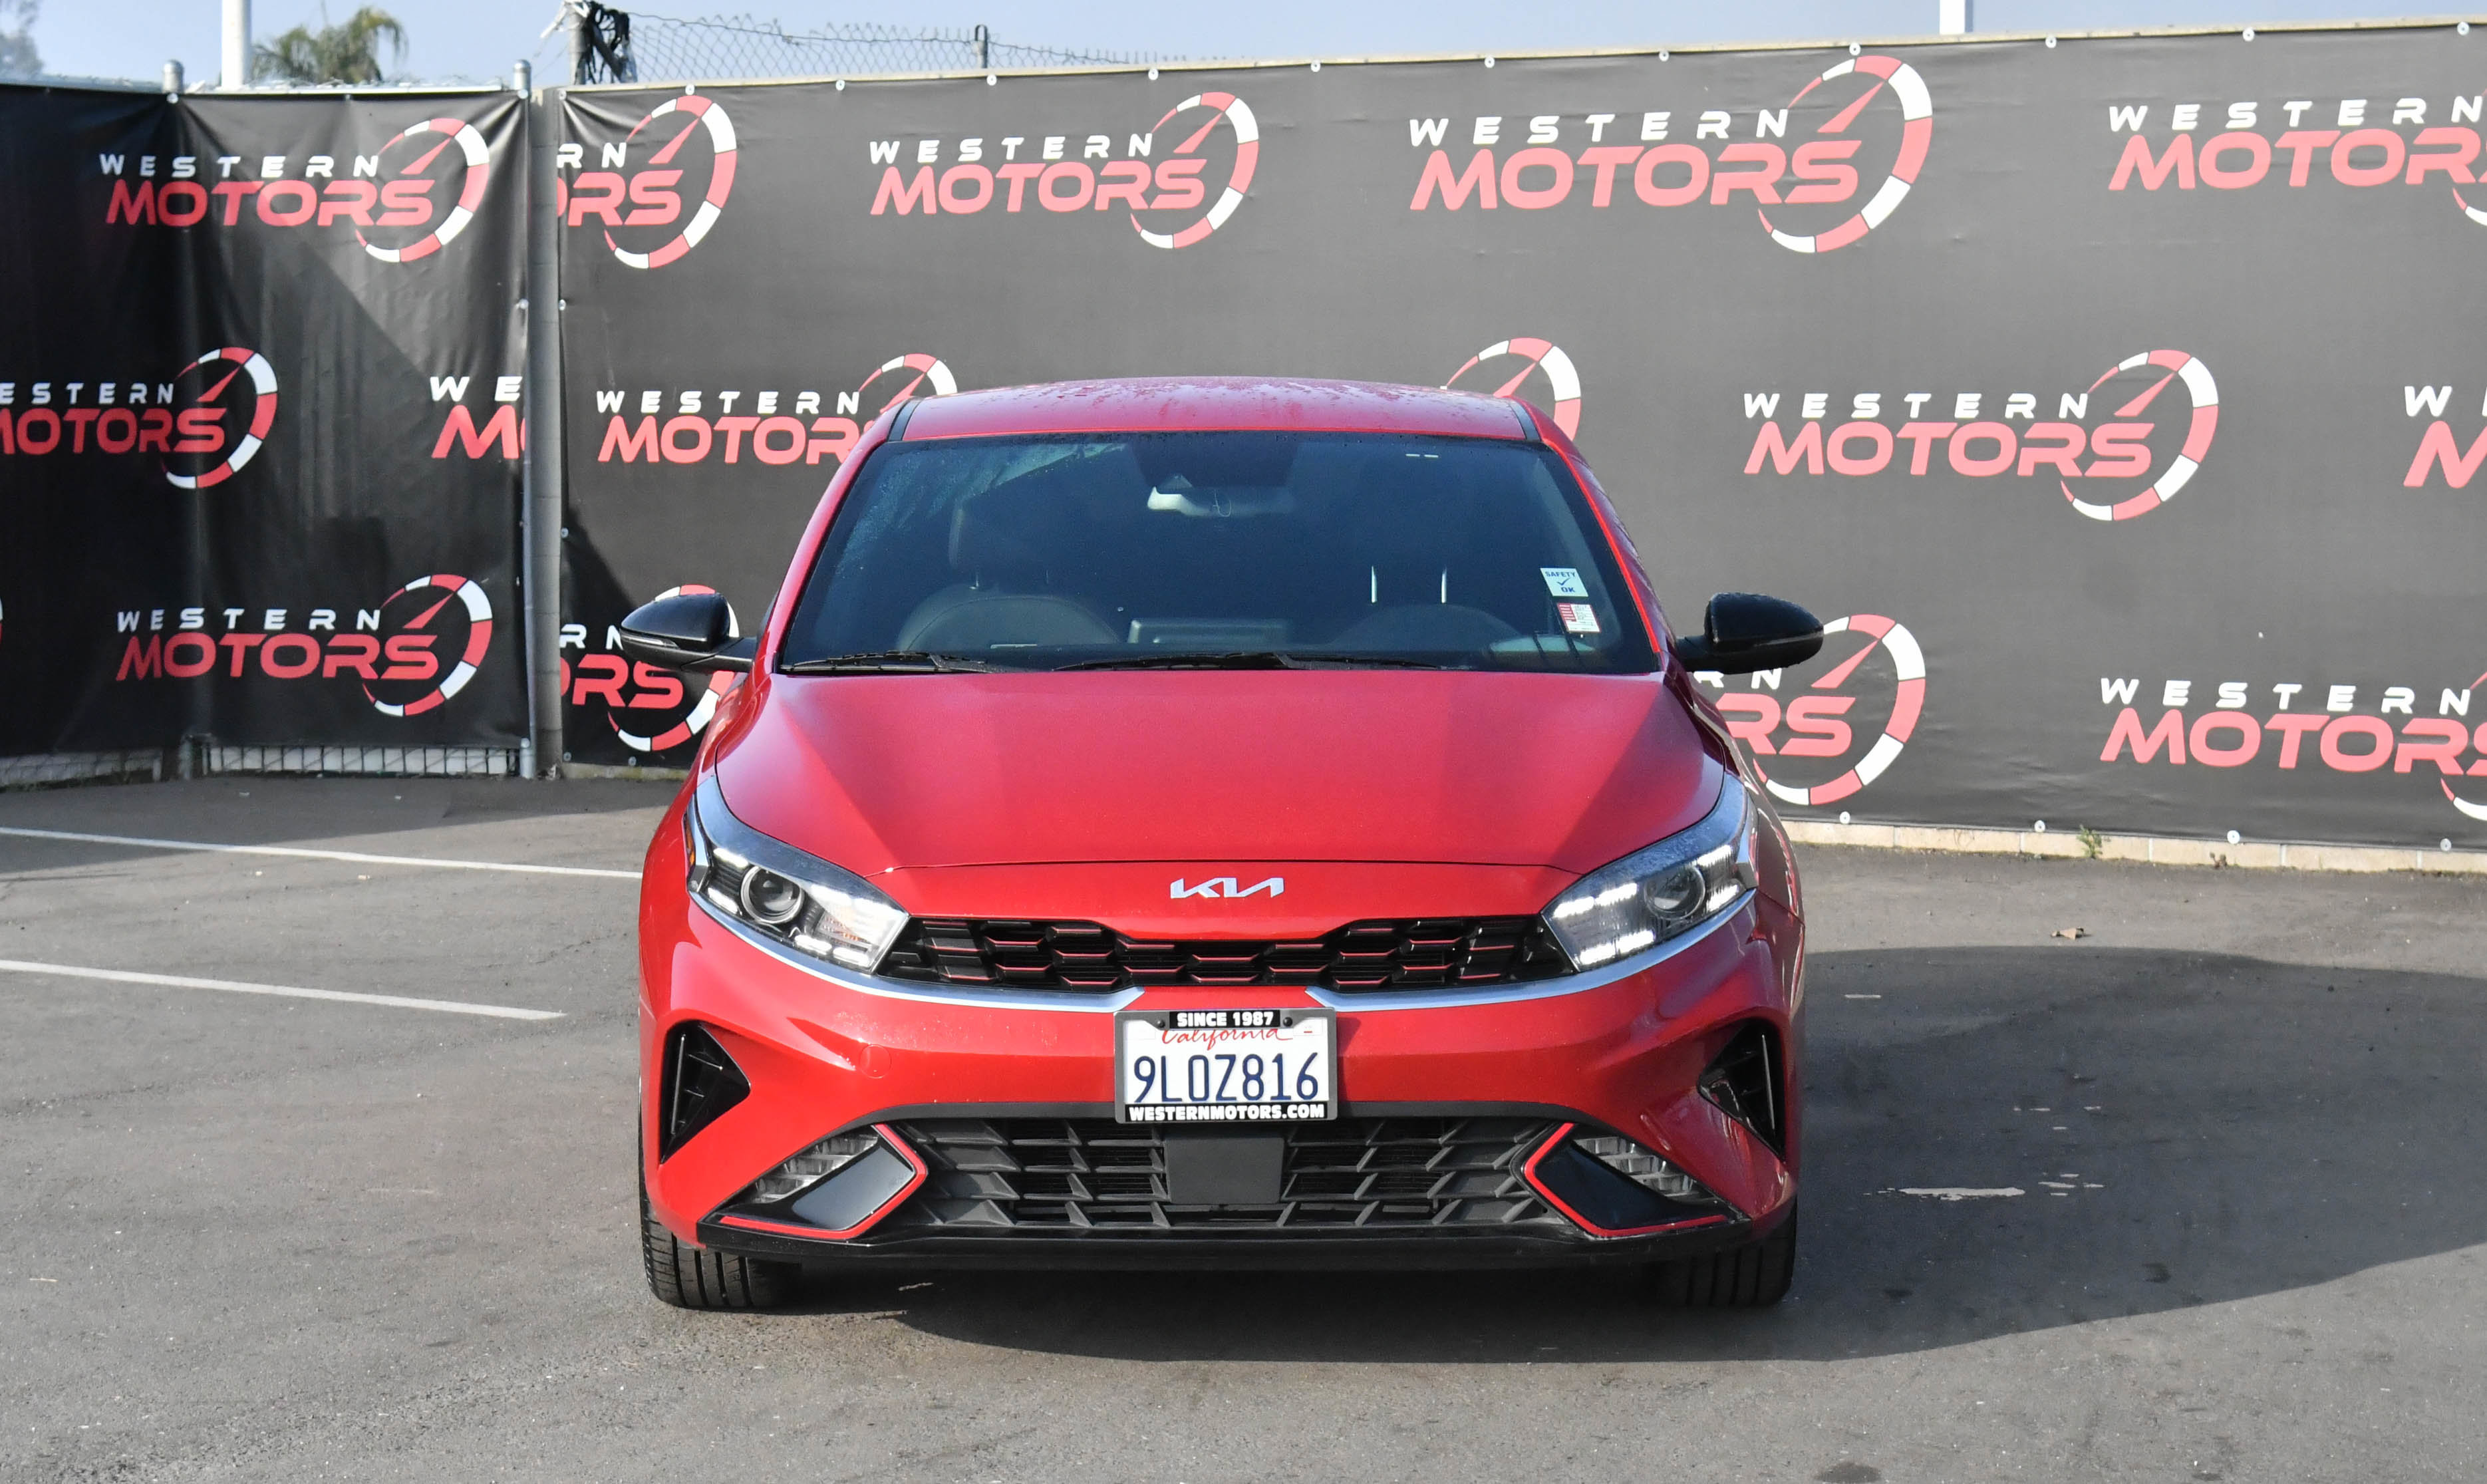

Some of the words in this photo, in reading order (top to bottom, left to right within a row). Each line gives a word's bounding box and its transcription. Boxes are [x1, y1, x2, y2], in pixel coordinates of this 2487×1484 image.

[1409, 109, 1789, 146] WESTERN
[2109, 96, 2483, 132] WESTERN
[99, 153, 379, 177] WESTERN
[869, 132, 1152, 164] WESTERN
[2108, 127, 2487, 191] MOTOR
[870, 159, 1207, 215] MOTORS
[1410, 140, 1861, 210] MOTORS
[106, 179, 436, 227] MOTORS
[597, 390, 859, 414] WESTERN
[1743, 393, 2088, 419] WESTERN
[598, 415, 875, 465] MOTOR
[1743, 421, 2155, 477] MOTORS
[116, 608, 380, 632] WESTERN
[116, 633, 438, 682] MOTORS
[2101, 678, 2470, 716] WESTERN
[2100, 707, 2487, 776] MOTOR
[1177, 1012, 1227, 1027] SINCE
[1233, 1012, 1274, 1026] 1987
[1161, 1028, 1293, 1051] California
[1129, 1104, 1324, 1121] WESTERNMOTORS.COM
